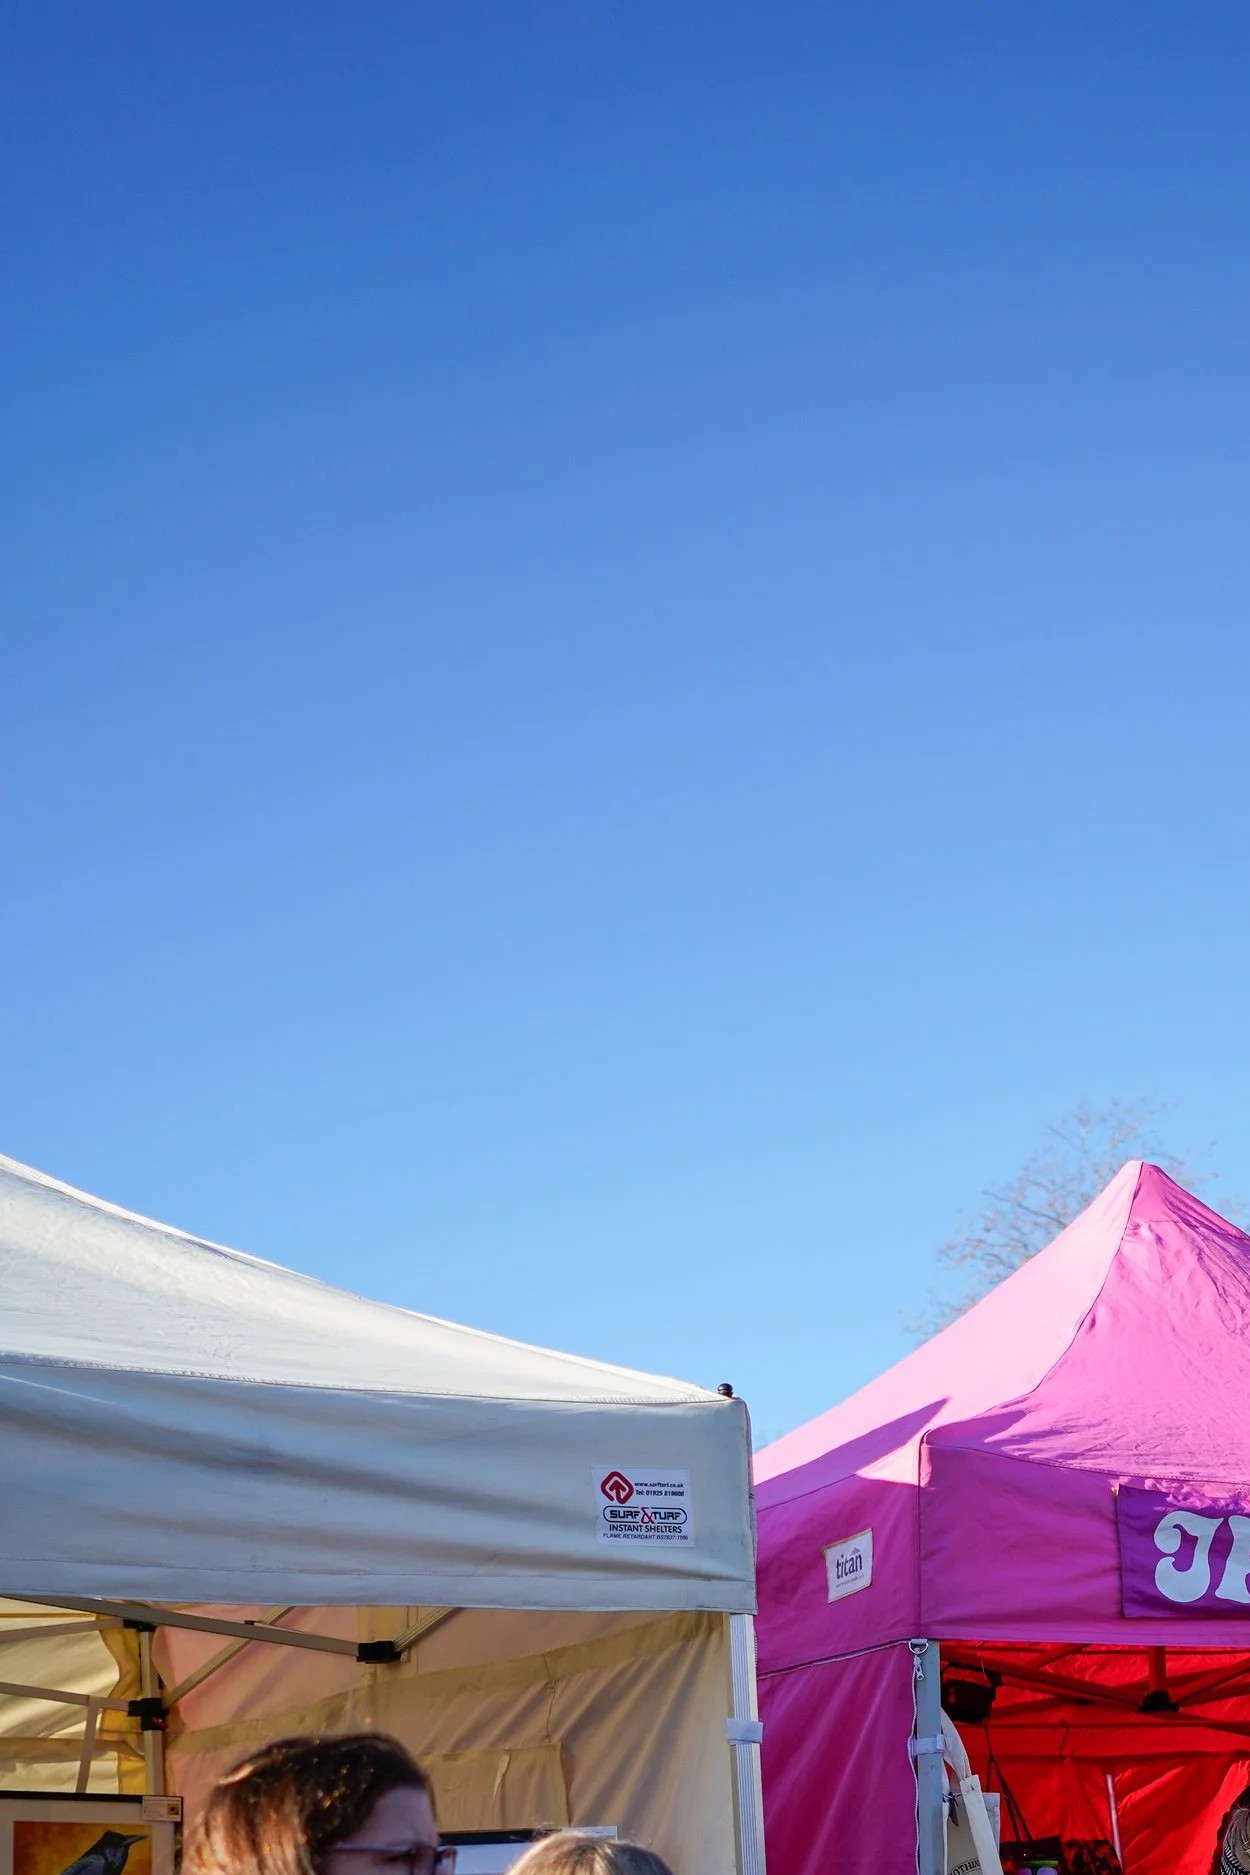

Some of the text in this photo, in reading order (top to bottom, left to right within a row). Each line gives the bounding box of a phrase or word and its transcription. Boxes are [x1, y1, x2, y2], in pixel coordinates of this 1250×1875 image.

[610, 1507, 681, 1524] SURF & TURF
[610, 1524, 643, 1532] INSTANT
[836, 1554, 862, 1579] titan
